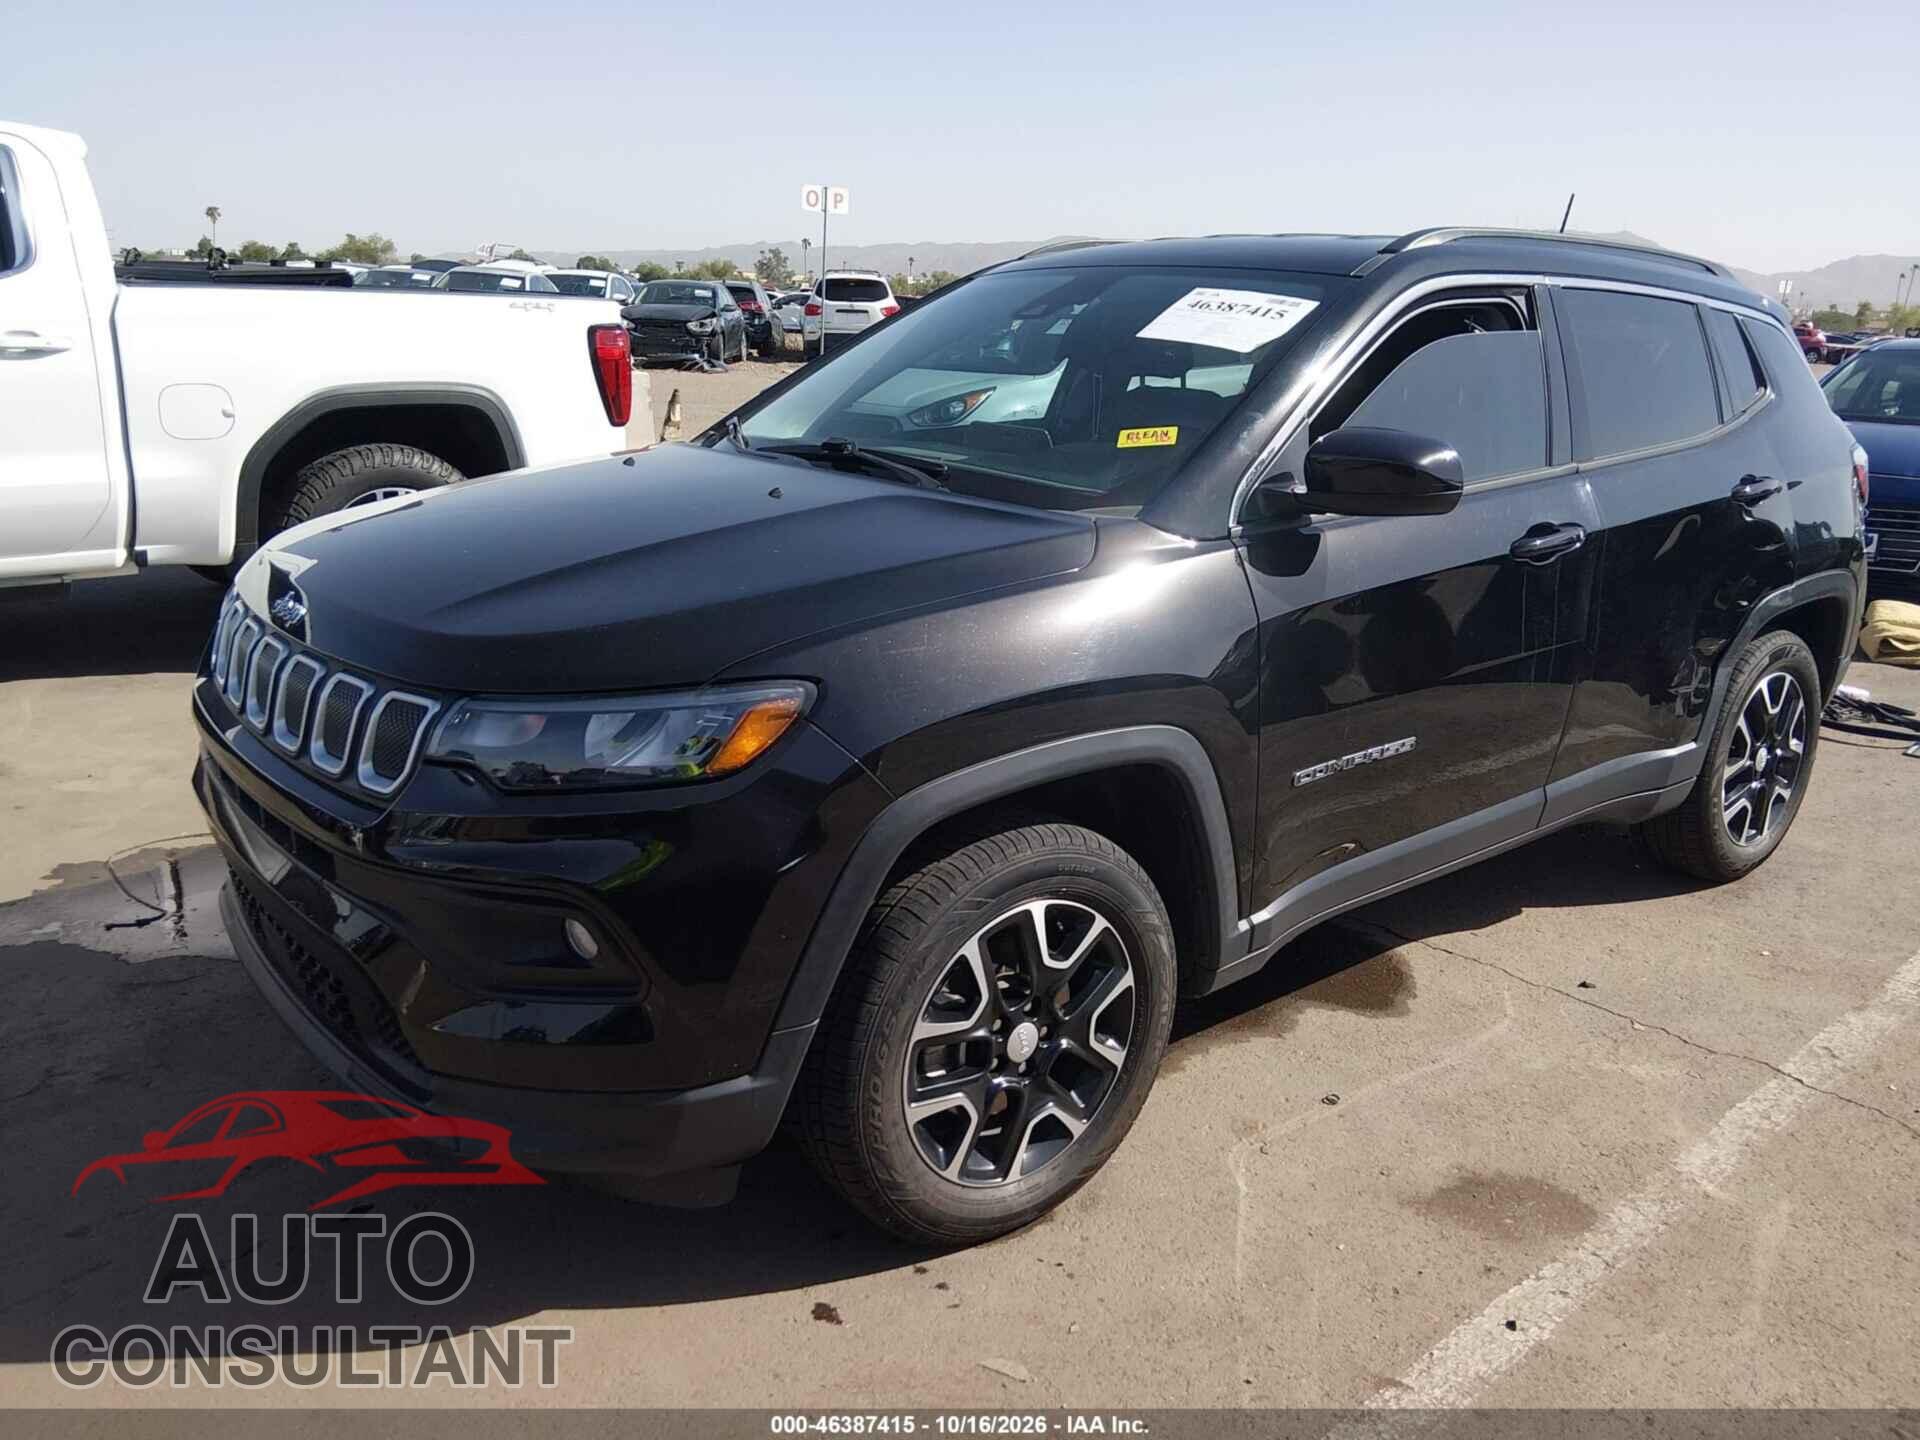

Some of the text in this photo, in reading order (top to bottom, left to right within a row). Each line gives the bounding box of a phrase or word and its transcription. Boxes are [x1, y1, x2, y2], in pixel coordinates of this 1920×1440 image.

[806, 190, 819, 208] O
[834, 192, 844, 209] P
[1187, 300, 1288, 320] 46387415
